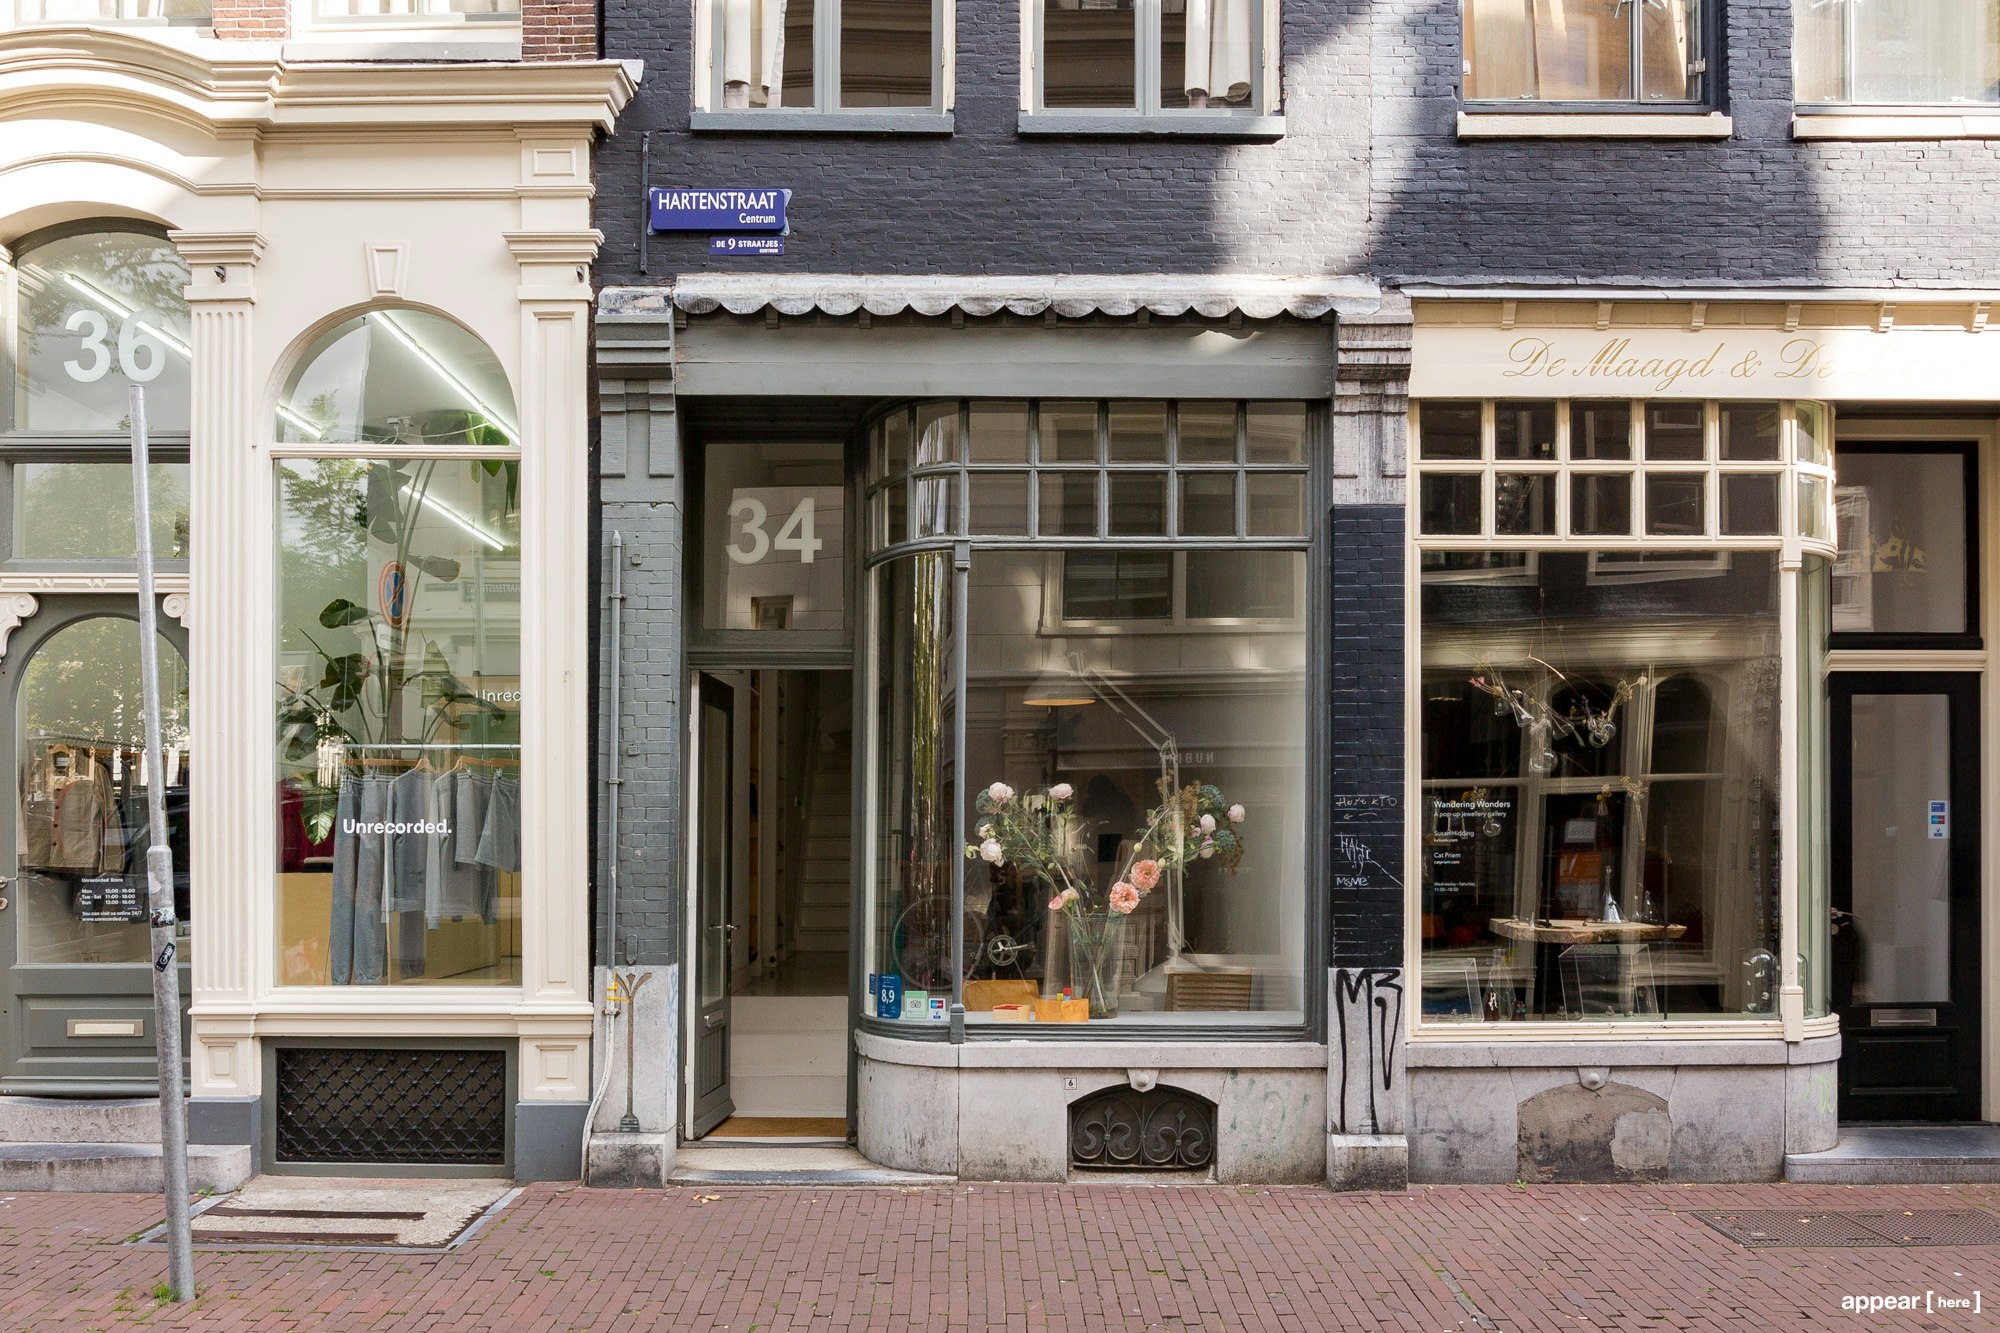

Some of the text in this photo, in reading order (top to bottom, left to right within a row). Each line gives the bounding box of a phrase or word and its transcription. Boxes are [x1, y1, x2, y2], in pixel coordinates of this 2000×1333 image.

[658, 192, 777, 210] HARTENSTRAAT
[739, 213, 776, 224] Centrum
[716, 238, 779, 250] DE 9 STRAATJES
[63, 308, 166, 383] 36
[1503, 337, 1566, 378] De
[1572, 337, 1726, 392] Maagd
[1730, 350, 1762, 378] &
[725, 497, 823, 565] 34
[1433, 800, 1511, 810] Wandering Wonders
[342, 818, 453, 834] Unrecorded.
[881, 989, 895, 1004] 8,9
[1068, 1079, 1074, 1087] 6
